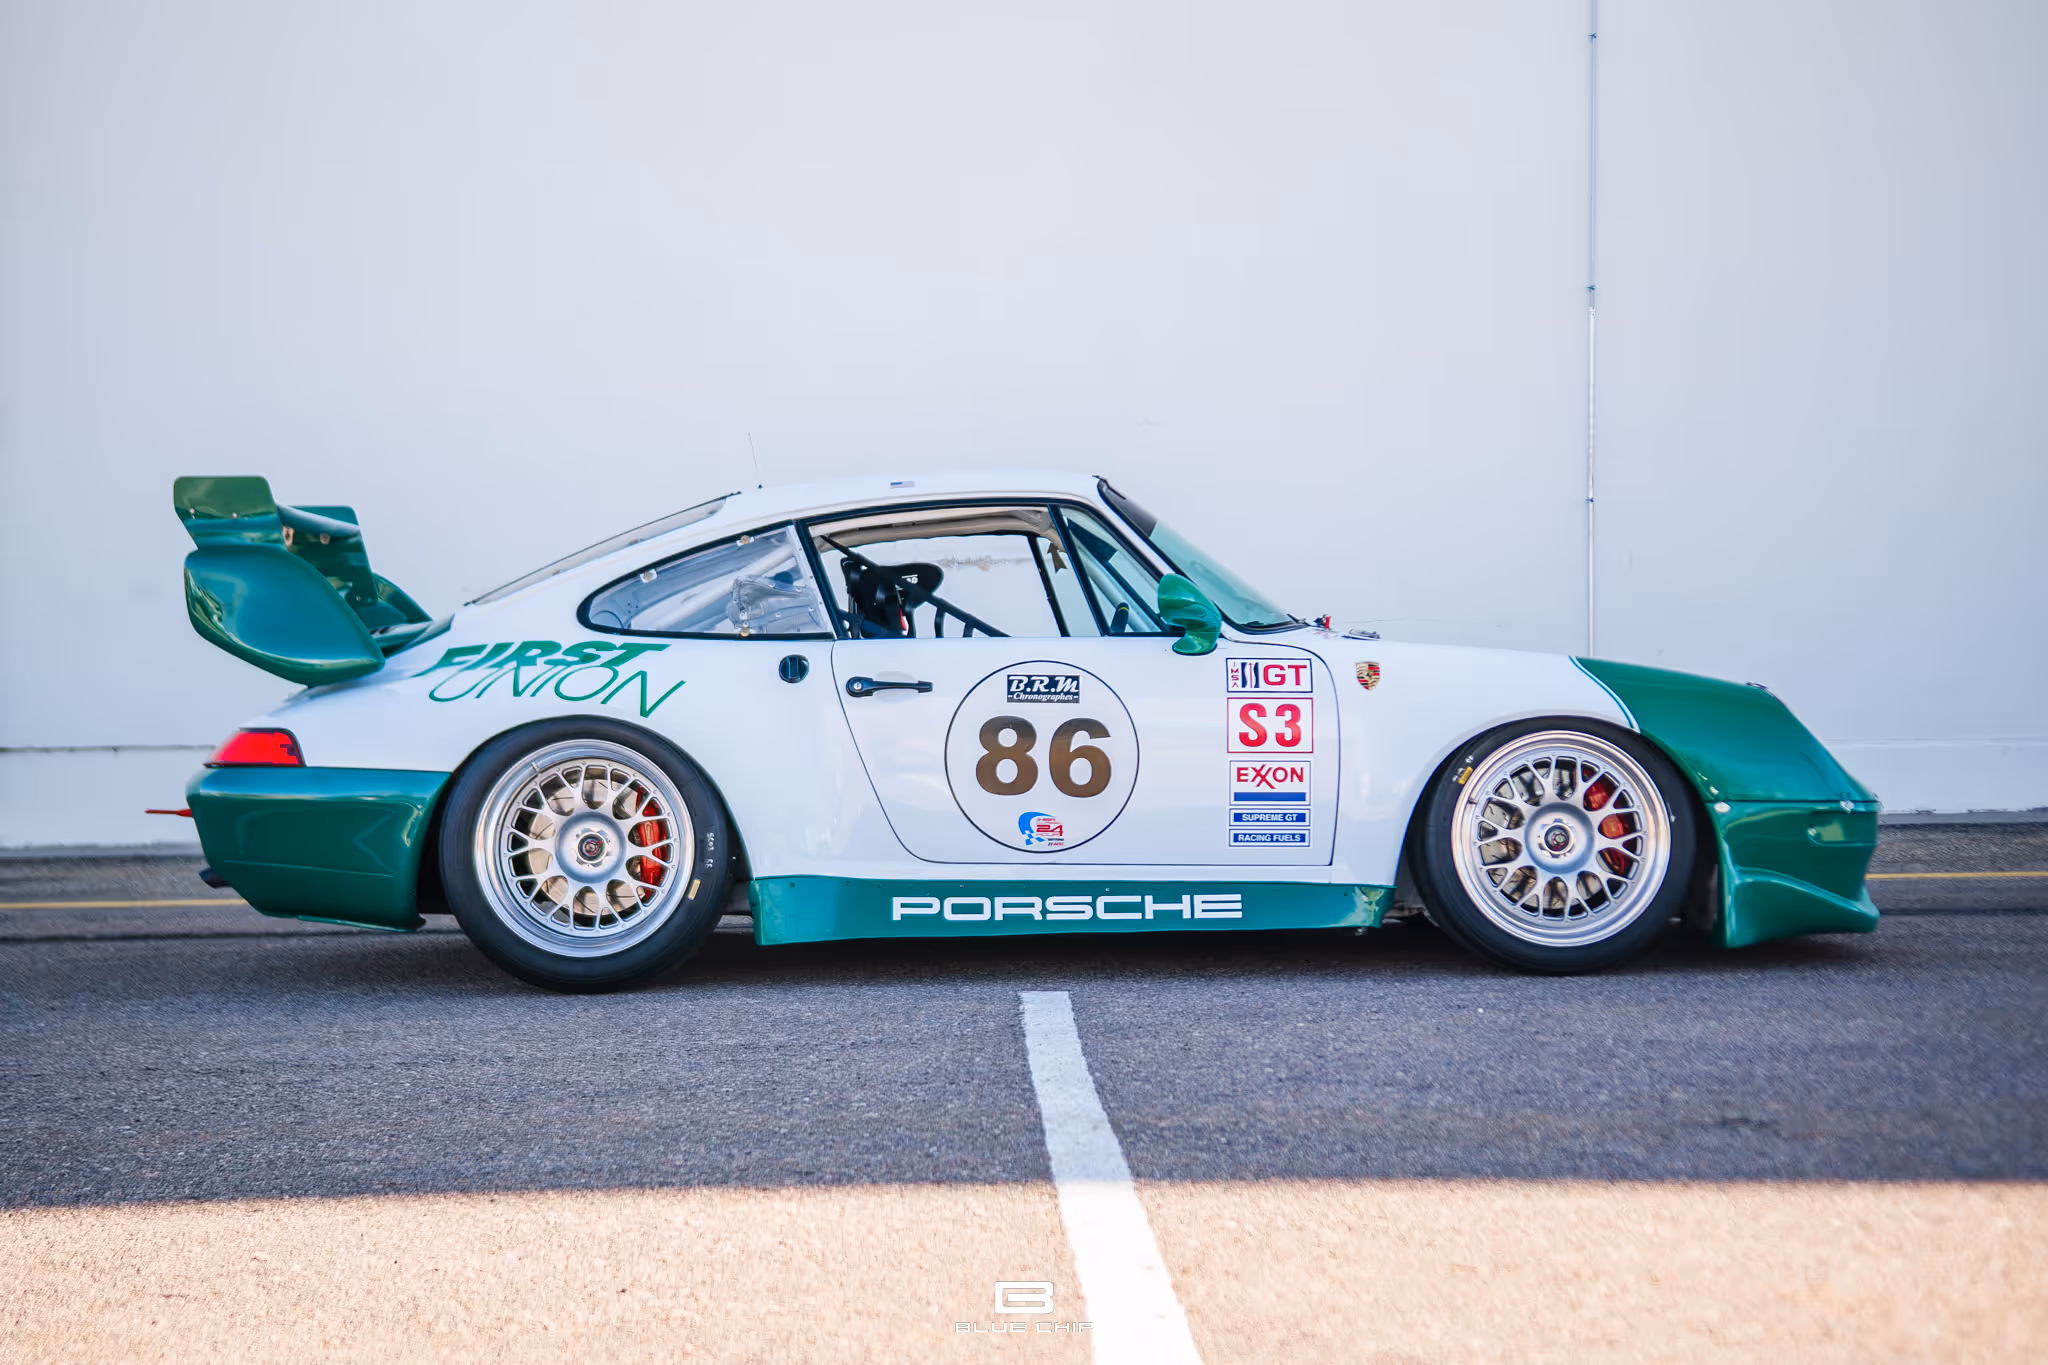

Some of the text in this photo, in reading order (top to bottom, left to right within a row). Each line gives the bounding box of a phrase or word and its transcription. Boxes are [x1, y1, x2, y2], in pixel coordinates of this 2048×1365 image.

[409, 640, 673, 678] FIRST
[1263, 664, 1308, 686] GT
[428, 664, 687, 718] UNION
[1239, 702, 1302, 748] S3
[975, 715, 1112, 798] 86
[1236, 763, 1304, 789] EXXON
[1036, 824, 1063, 836] 24
[1241, 813, 1298, 822] SUPREME GT
[1238, 834, 1301, 842] RACING FUELS
[892, 893, 1243, 921] PORSCHE
